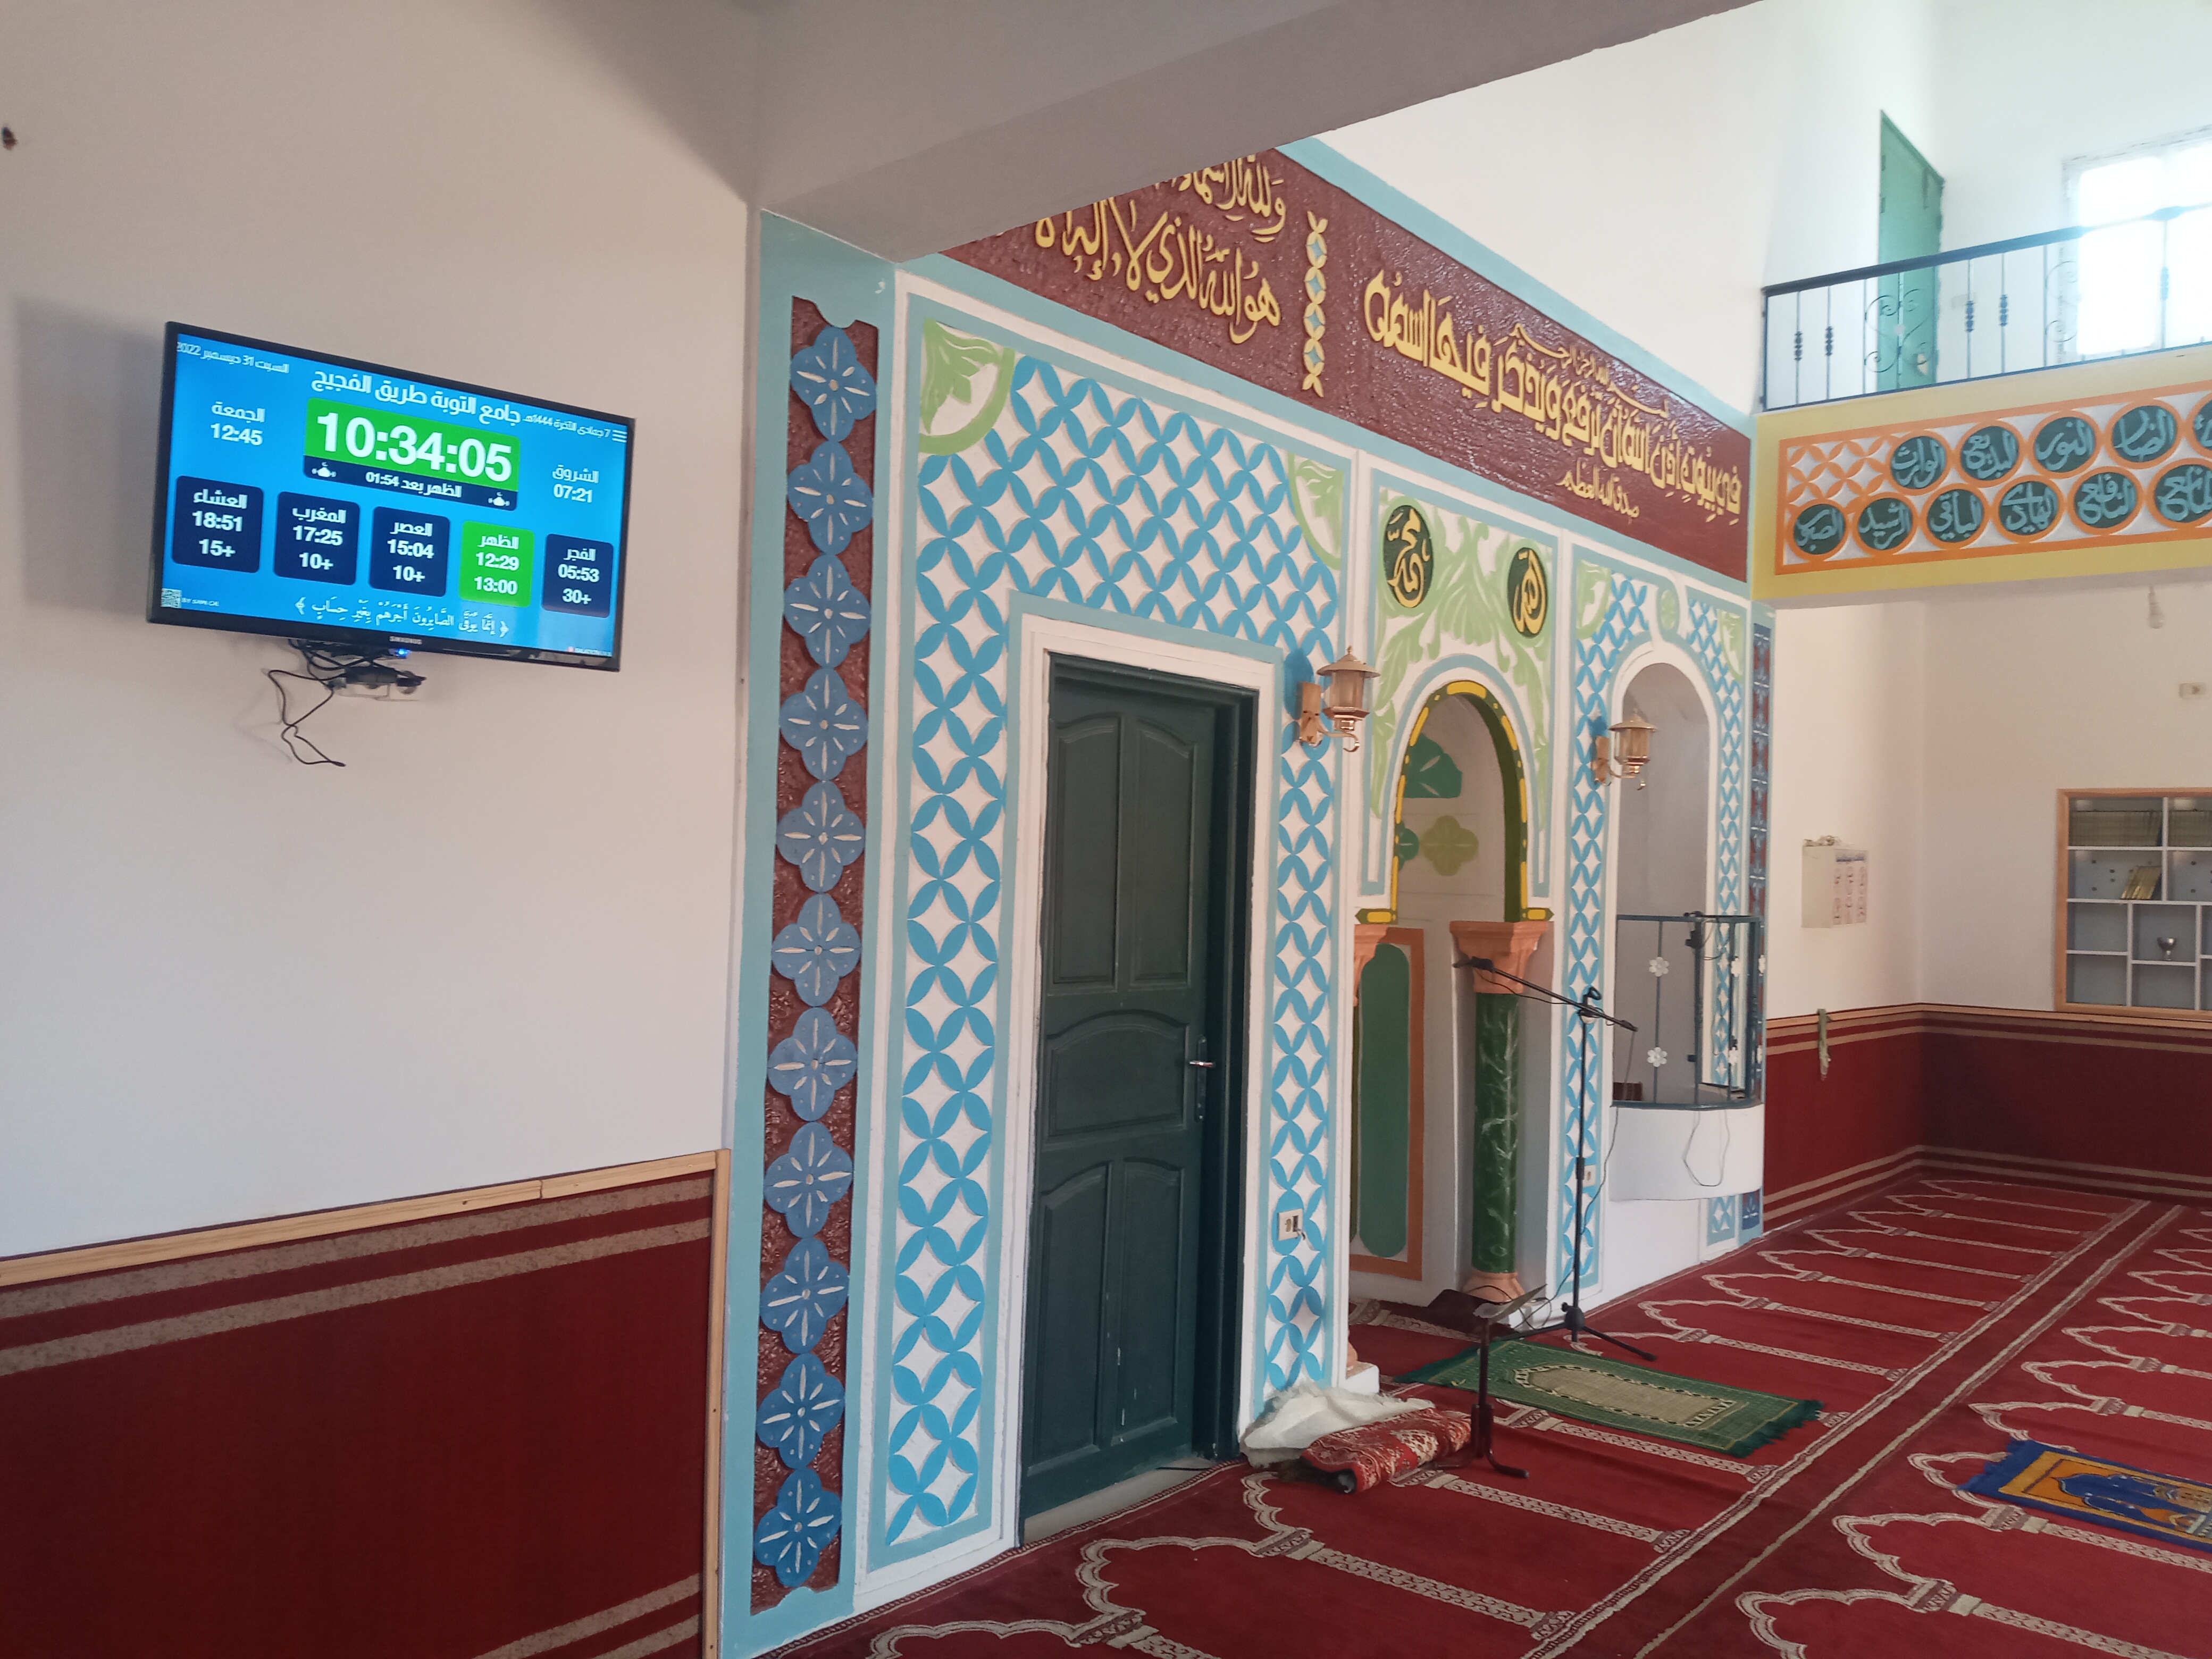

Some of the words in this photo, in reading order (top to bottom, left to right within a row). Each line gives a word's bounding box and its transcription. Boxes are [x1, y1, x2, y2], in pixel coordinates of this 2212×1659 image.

[177, 341, 202, 356] 2022
[200, 349, 241, 365] ديسمبر
[242, 355, 255, 366] 31
[255, 361, 290, 374] السبت
[311, 370, 372, 393] الفجيج
[374, 380, 428, 405] طريق
[211, 400, 265, 423] الجمعة
[430, 390, 477, 415] التوبة
[479, 404, 521, 426] جامع
[210, 423, 263, 446] 12:45
[604, 429, 611, 438] 7
[316, 412, 512, 482] 10:34:05
[365, 471, 400, 487] 01:54
[552, 464, 599, 484] الشروق
[400, 480, 423, 494] بعد
[423, 482, 462, 498] الظهر
[553, 483, 593, 504] 07:21
[192, 488, 248, 509] العشاء
[192, 510, 243, 532] 18:51
[292, 507, 346, 524] المغرب
[292, 525, 343, 546] 17:25
[390, 521, 433, 537] العصر
[198, 539, 236, 558] 15+
[387, 539, 434, 559] 15:04
[477, 533, 520, 550] الظهر
[299, 552, 334, 571] 10+
[475, 552, 520, 572] 12:29
[563, 548, 596, 562] الفجر
[392, 565, 425, 583] 10+
[557, 563, 600, 583] 05:53
[474, 576, 518, 596] 13:00
[562, 588, 592, 605] 30+
